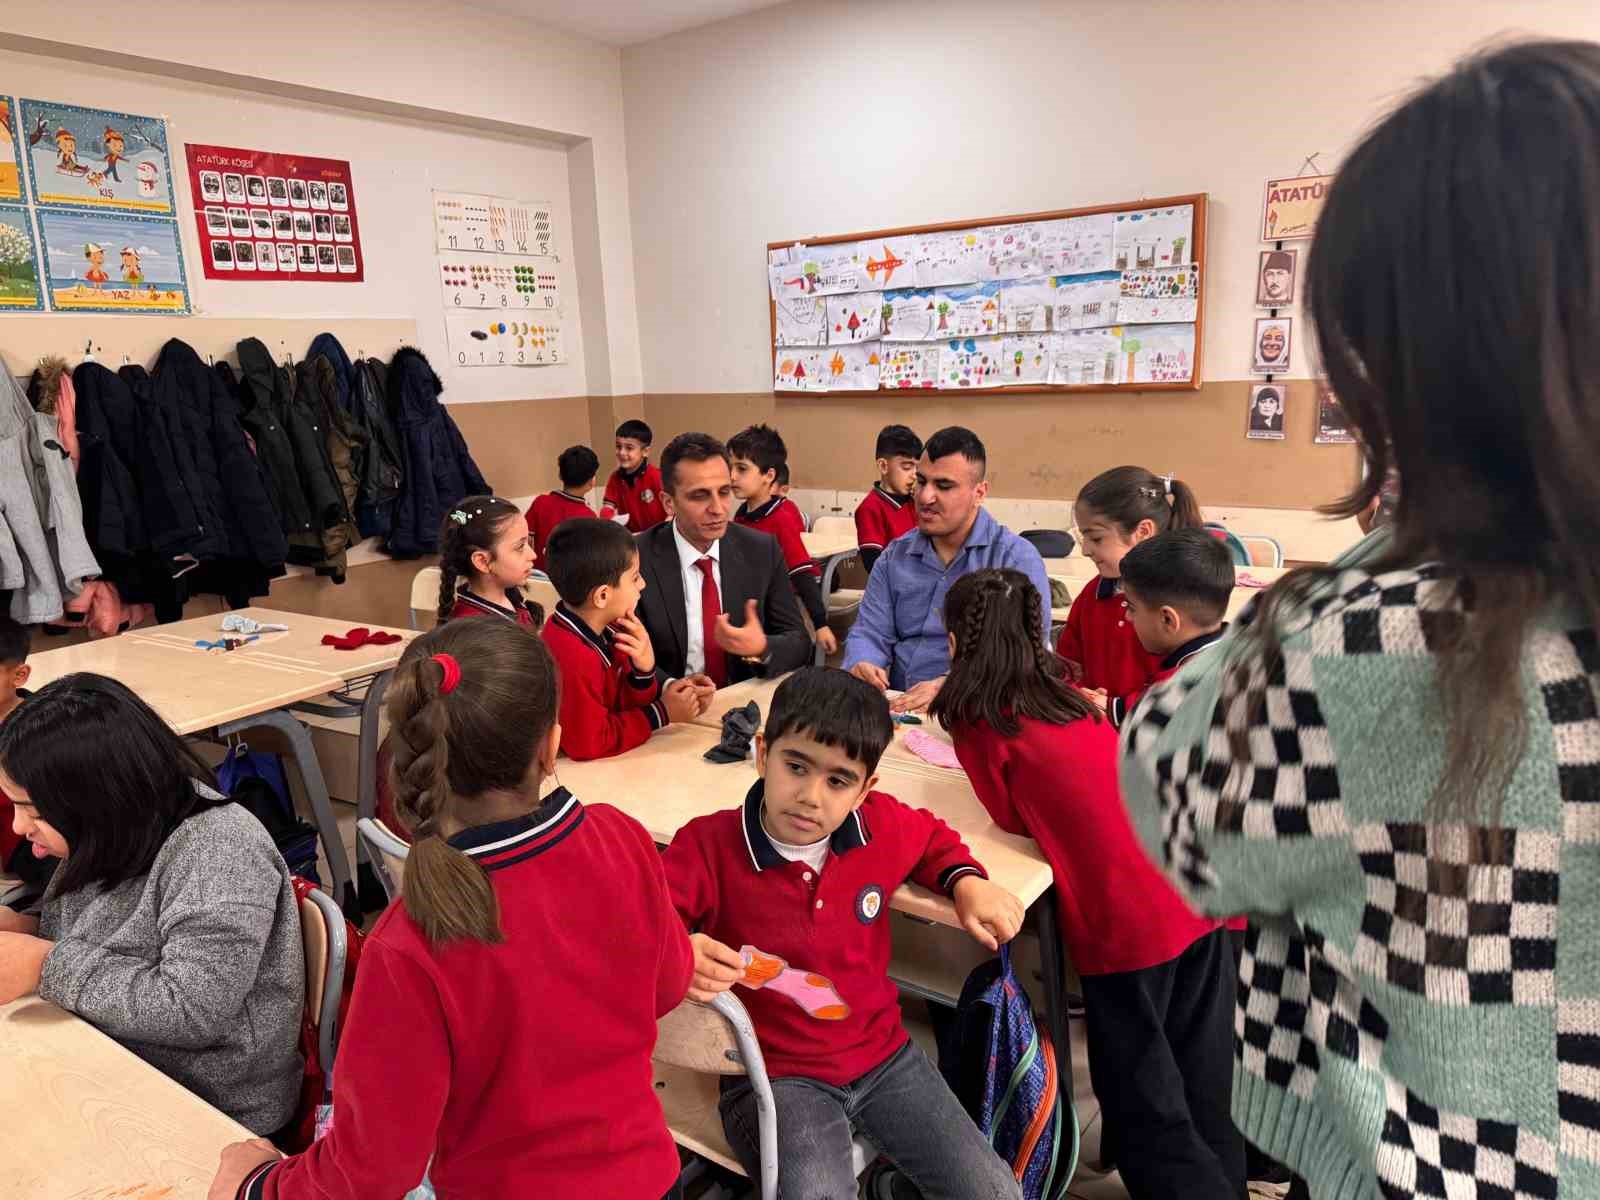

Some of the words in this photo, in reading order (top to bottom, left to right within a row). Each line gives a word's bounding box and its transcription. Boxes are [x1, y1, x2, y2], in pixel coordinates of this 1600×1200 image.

[448, 235, 459, 249] 11
[473, 237, 485, 250] 12
[494, 239, 505, 251] 13
[516, 240, 528, 252] 14
[539, 242, 549, 255] 15
[111, 289, 131, 301] YAZ
[454, 292, 462, 305] 6
[480, 293, 486, 305] 7
[501, 294, 508, 307] 8
[524, 295, 531, 307] 9
[544, 296, 554, 308] 10
[458, 351, 466, 364] 0
[479, 351, 485, 363] 1
[498, 351, 505, 364] 2
[518, 351, 525, 363] 3
[536, 351, 543, 363] 4
[551, 350, 558, 363] 5
